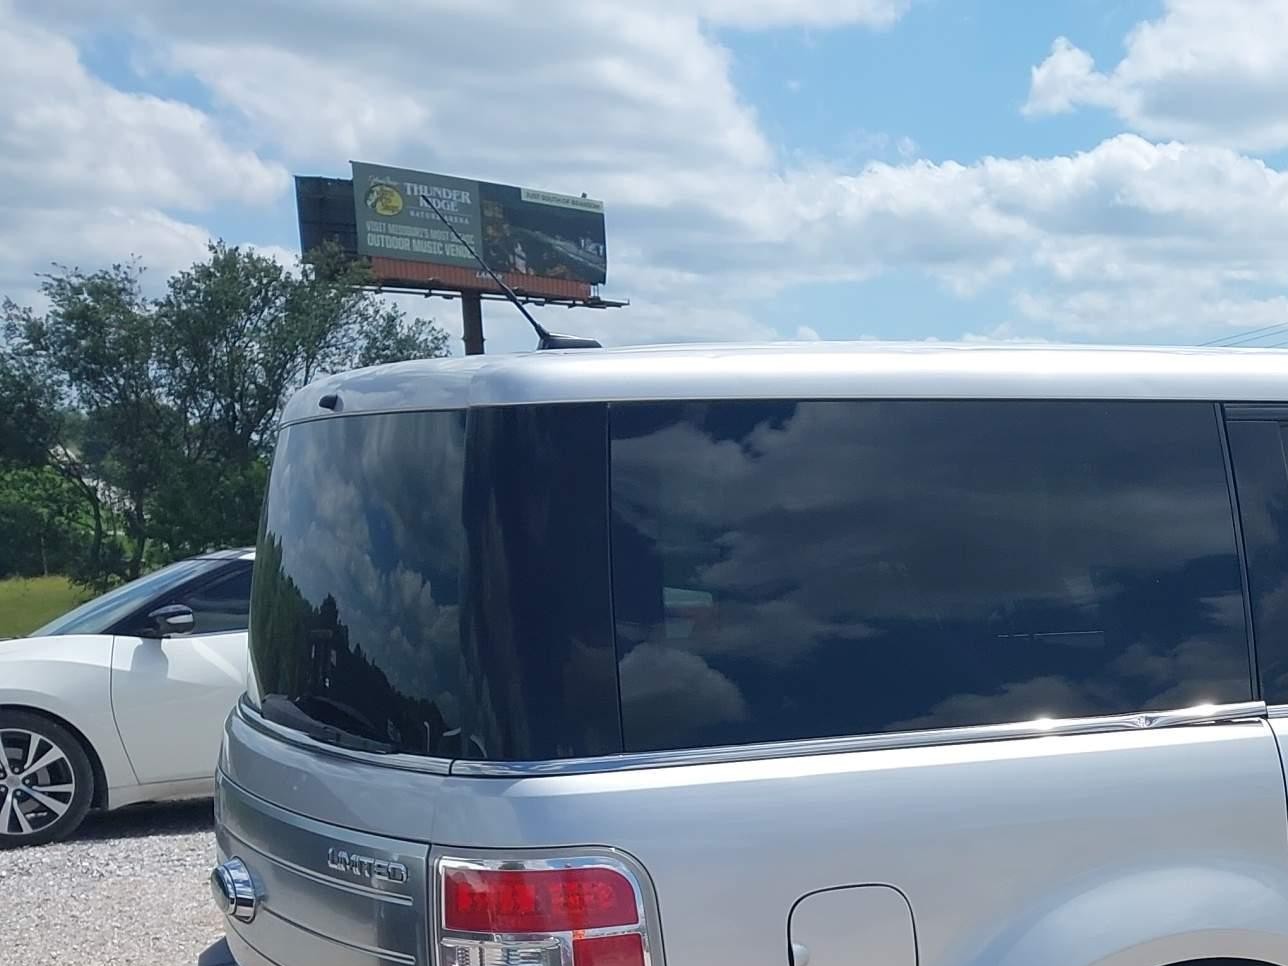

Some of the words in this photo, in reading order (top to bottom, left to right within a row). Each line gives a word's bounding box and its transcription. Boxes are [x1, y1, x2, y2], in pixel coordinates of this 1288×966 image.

[403, 182, 471, 204] THUNDER
[367, 232, 411, 252] OUTDOOR
[411, 238, 444, 256] MUSIC
[328, 847, 409, 885] LIMITED
